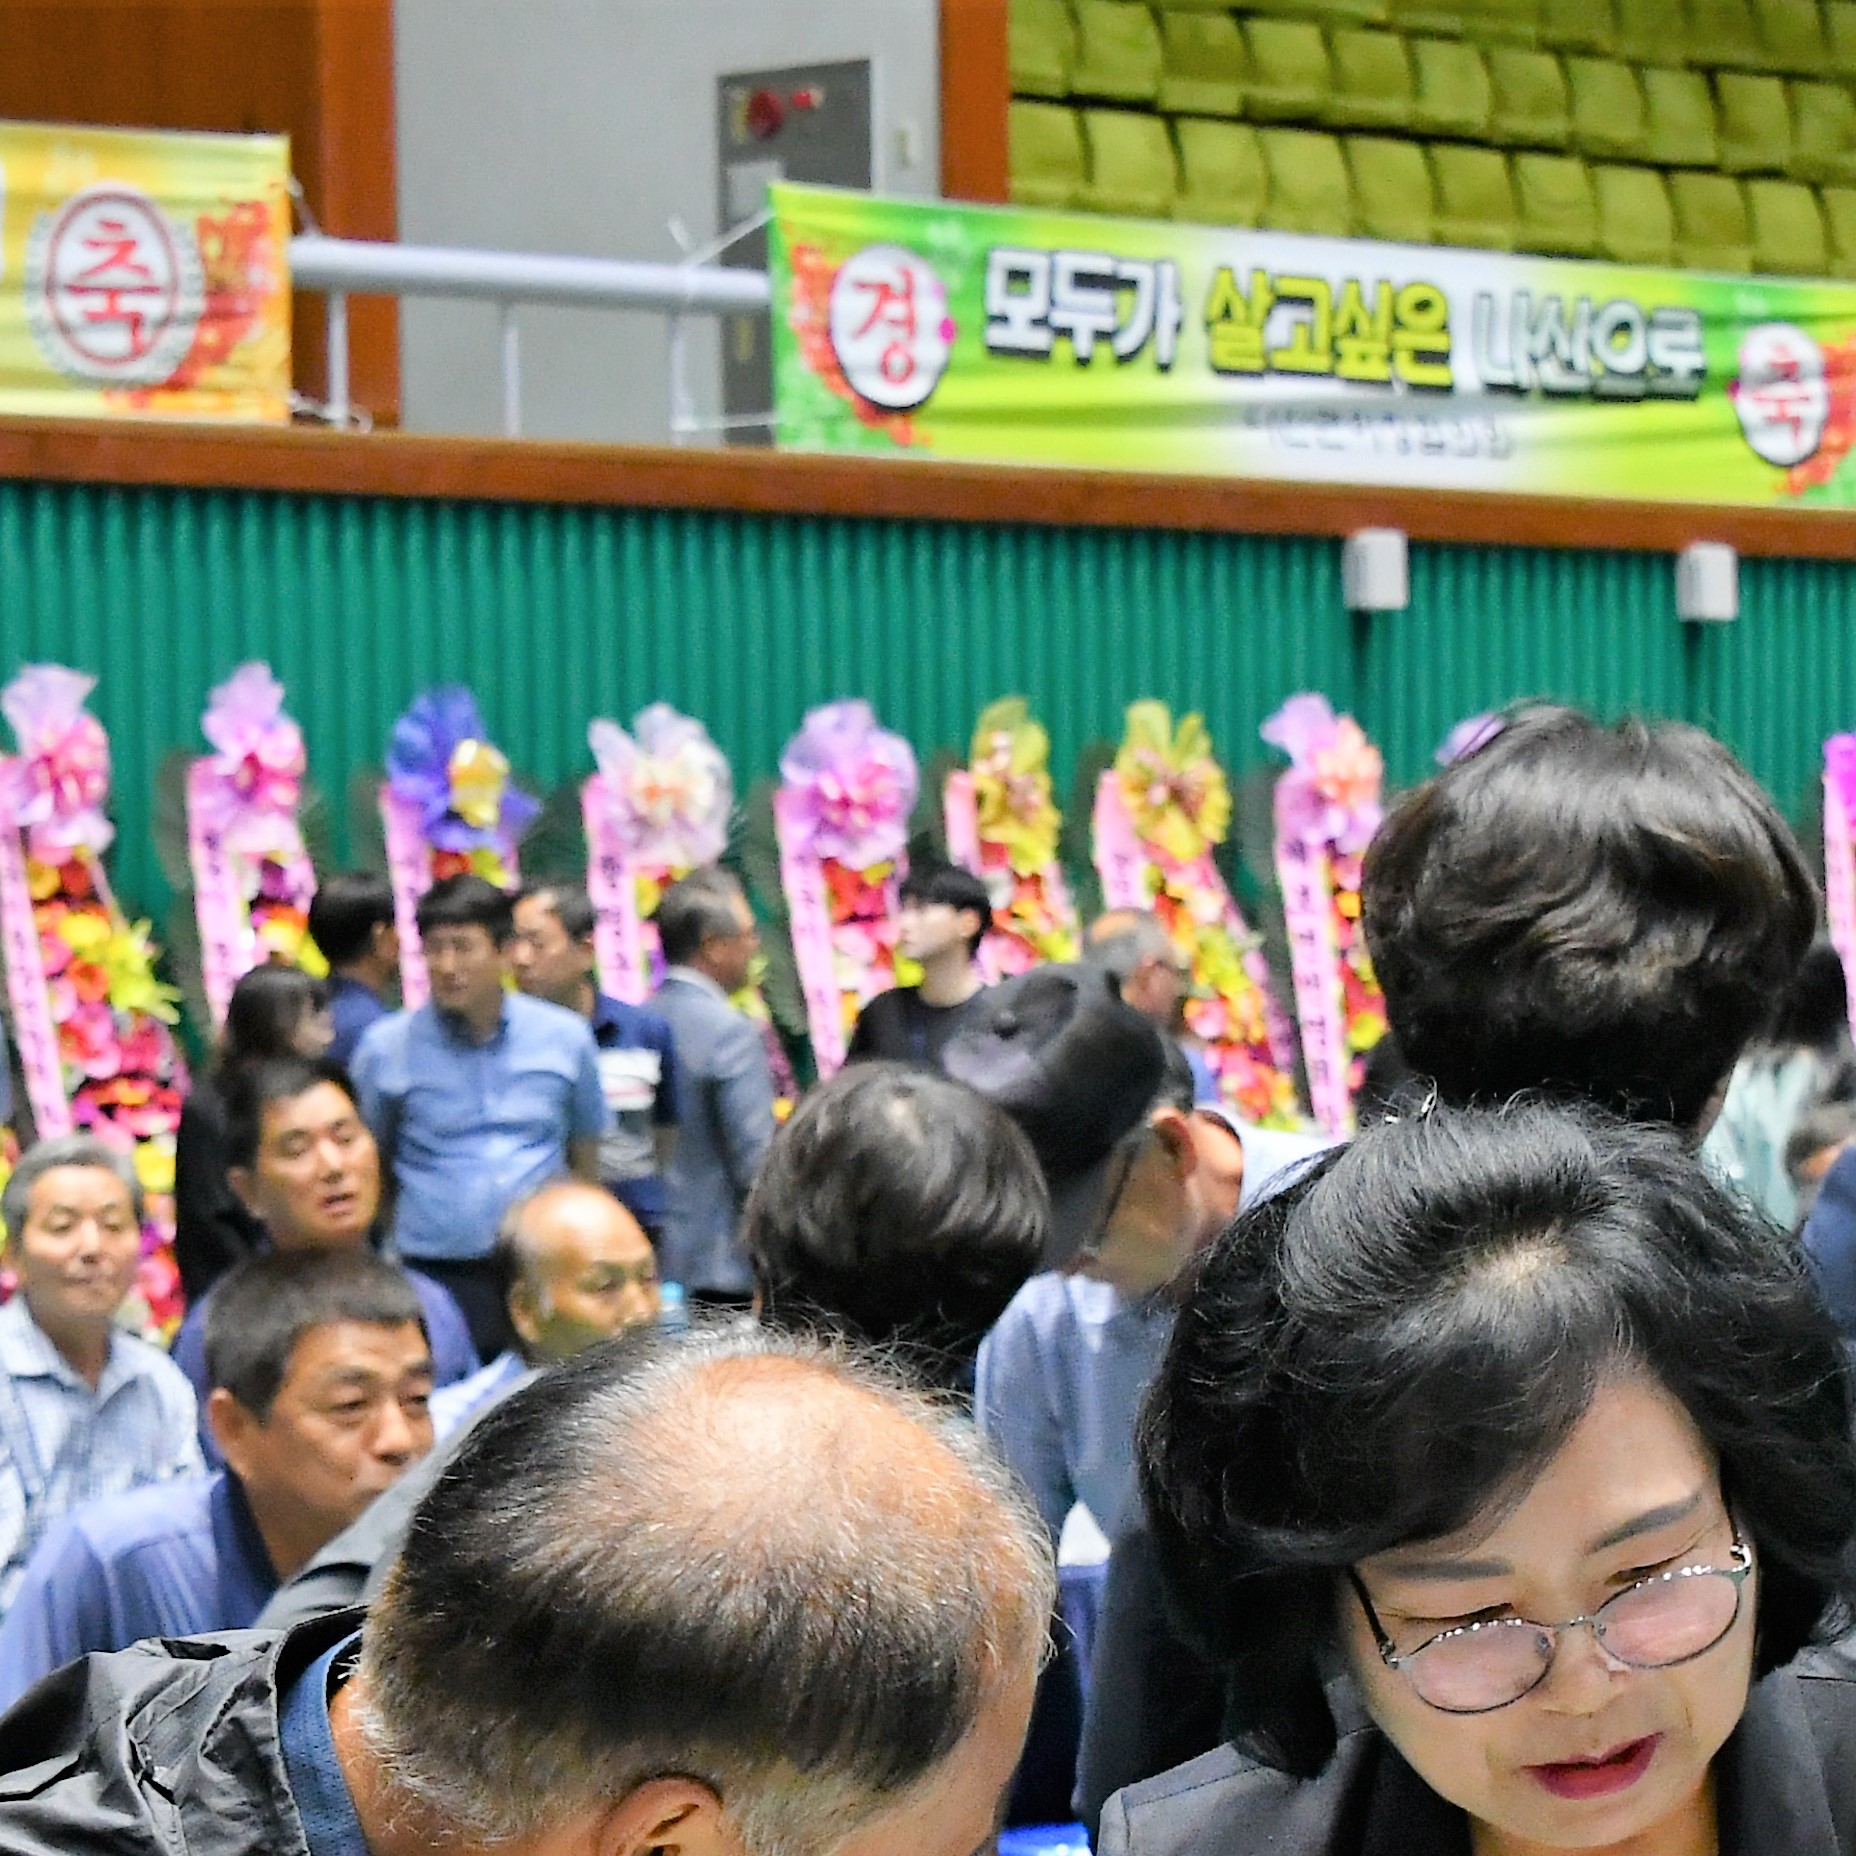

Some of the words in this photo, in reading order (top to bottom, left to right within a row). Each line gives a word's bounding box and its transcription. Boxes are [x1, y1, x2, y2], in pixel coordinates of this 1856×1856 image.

[61, 217, 162, 359] 축
[850, 271, 920, 388] 경
[982, 246, 1184, 373] 모두가
[1203, 264, 1456, 387] 살고싶은
[1472, 288, 1710, 400] 나산으로
